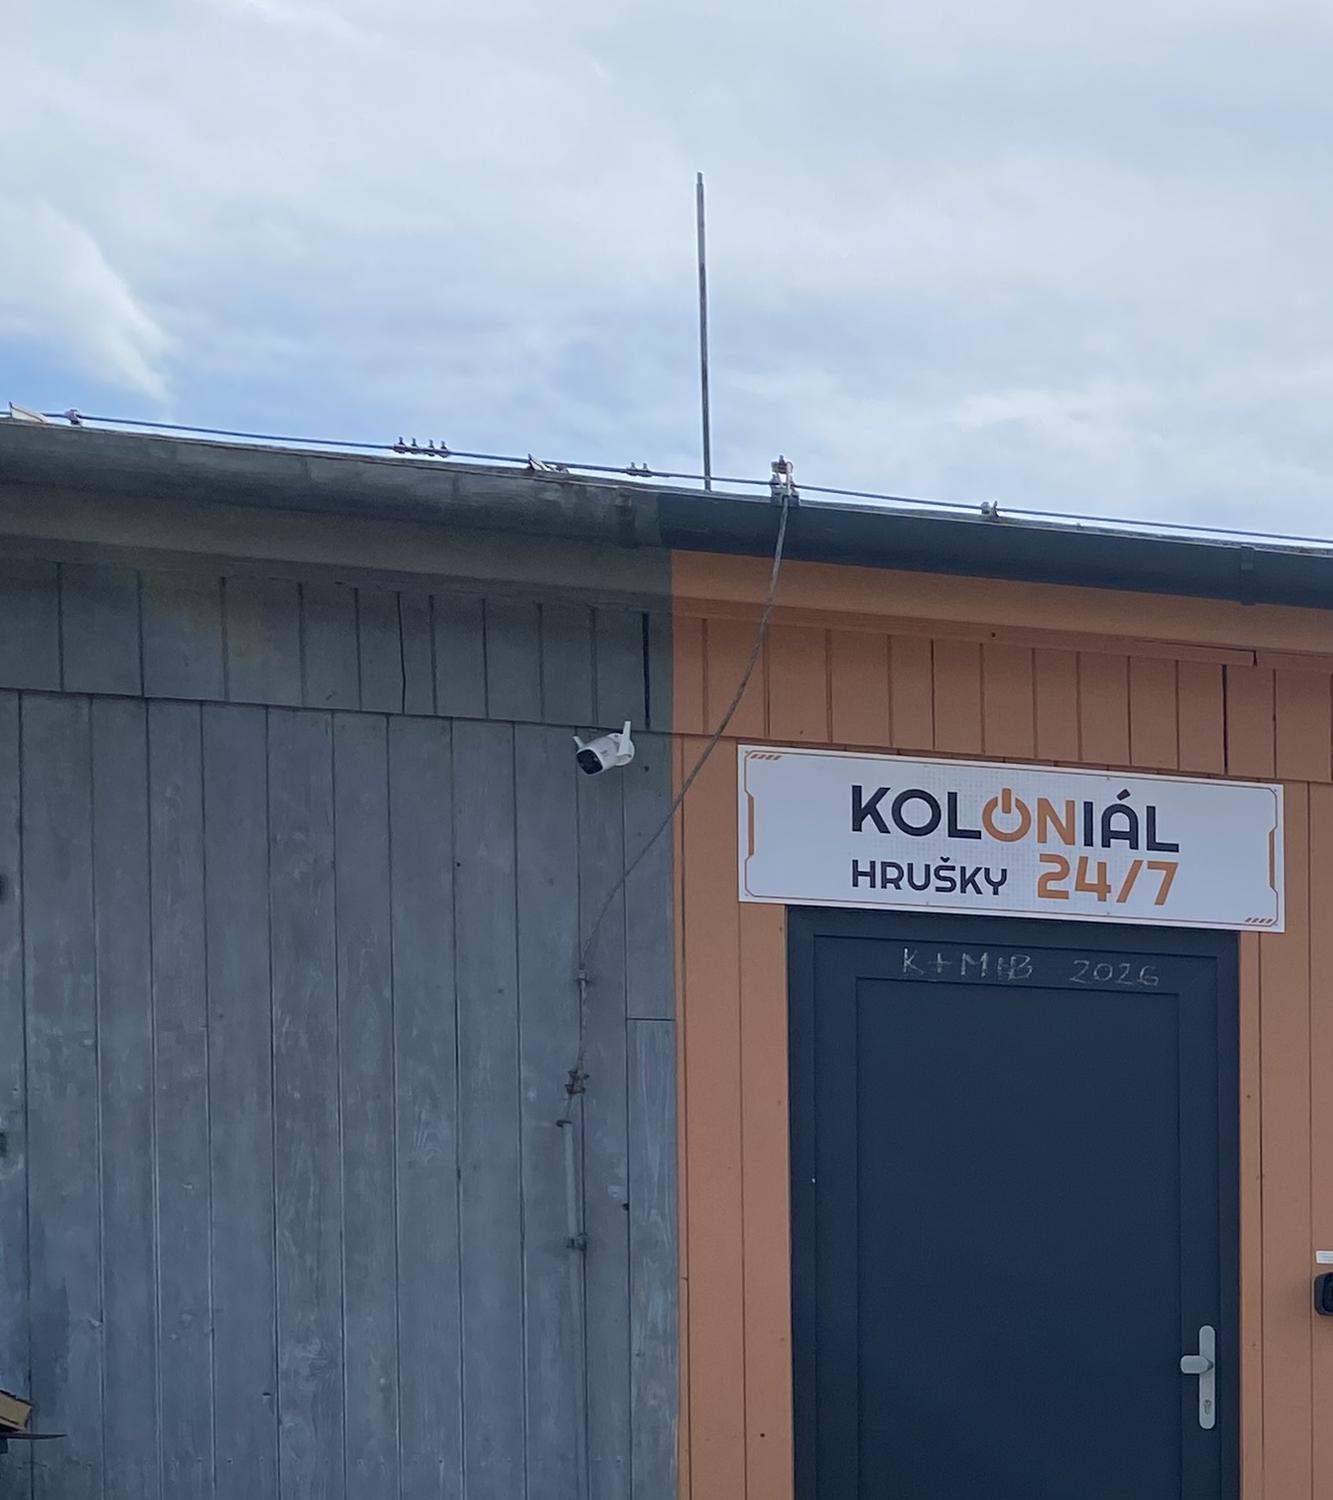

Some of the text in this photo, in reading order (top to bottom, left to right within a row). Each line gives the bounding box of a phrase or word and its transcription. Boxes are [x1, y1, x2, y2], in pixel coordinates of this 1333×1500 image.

[851, 785, 1180, 853] KOLONIÁL
[851, 853, 1179, 906] HRUŠKY 24/7
